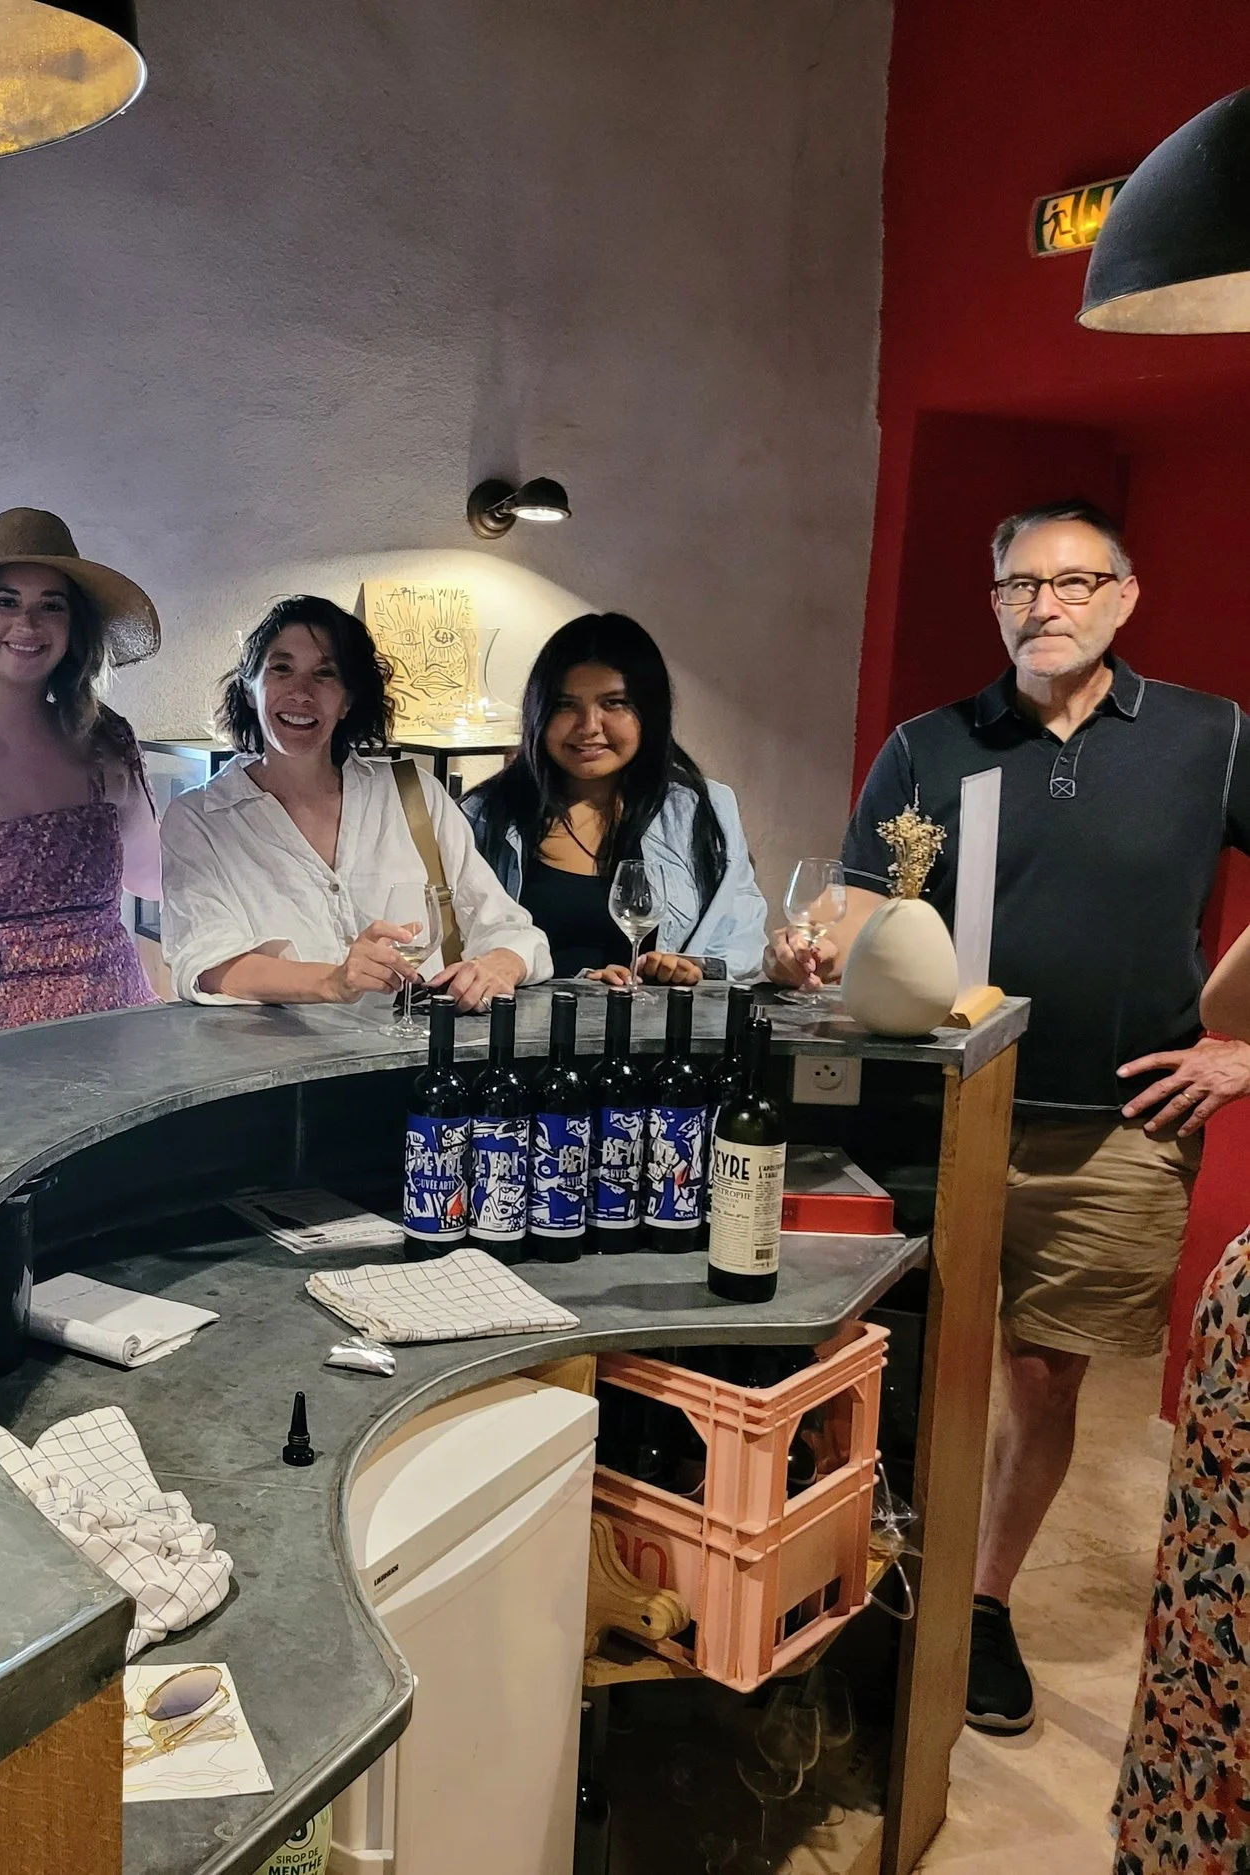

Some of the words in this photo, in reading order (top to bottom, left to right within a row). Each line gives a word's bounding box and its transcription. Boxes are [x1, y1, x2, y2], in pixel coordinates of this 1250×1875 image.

[715, 1149, 751, 1181] EYRE
[268, 1855, 323, 1875] MENTHE
[276, 1852, 307, 1864] SIROP
[308, 1846, 319, 1859] DE
